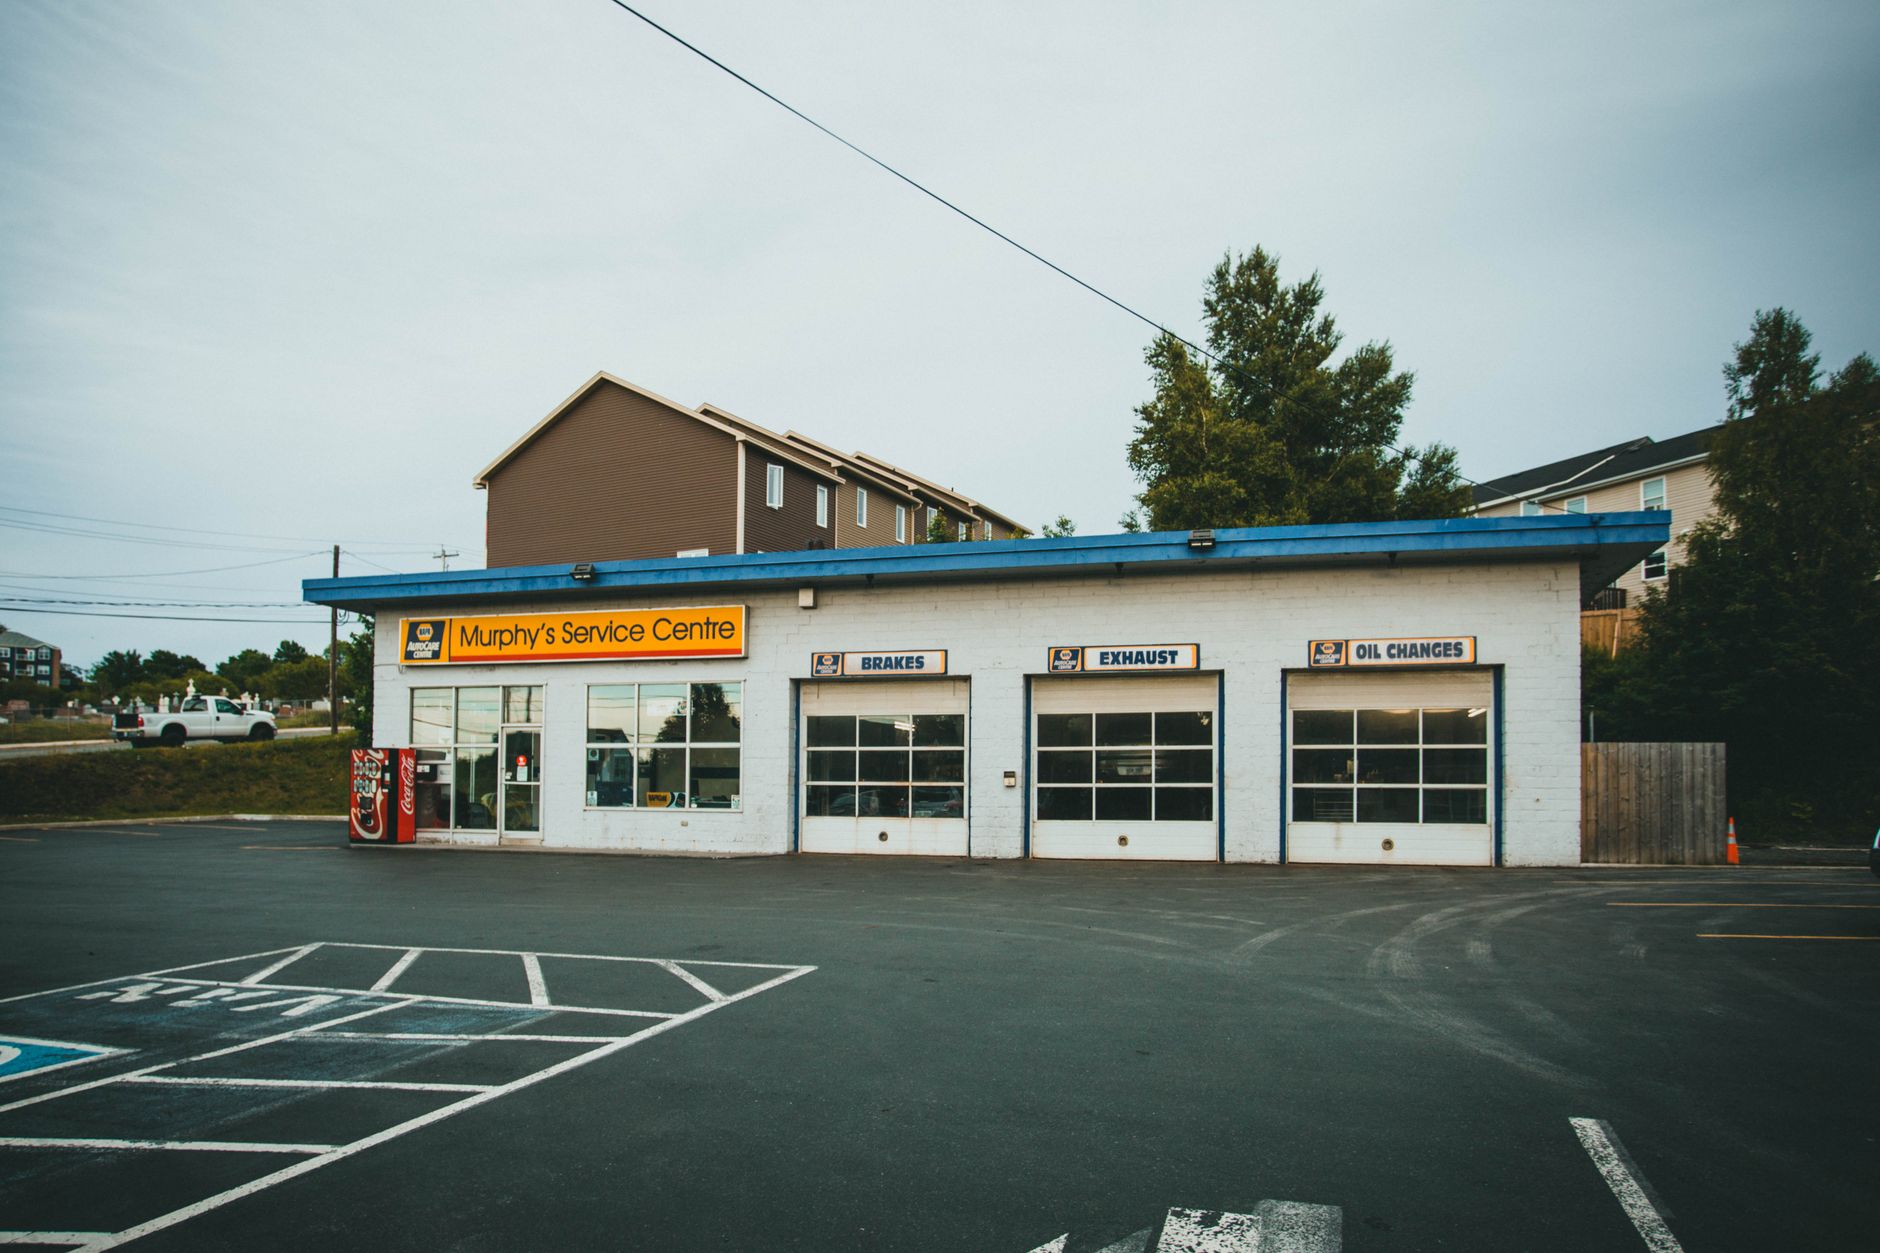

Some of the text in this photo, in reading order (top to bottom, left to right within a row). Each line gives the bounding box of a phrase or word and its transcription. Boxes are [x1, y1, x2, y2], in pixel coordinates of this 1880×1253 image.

[460, 616, 735, 651] Murphy's Service Centre
[1099, 650, 1178, 665] EXHAUST
[1356, 644, 1381, 659] OIL
[1386, 642, 1463, 659] CHANGES
[861, 656, 925, 670] BRAKES
[401, 753, 414, 815] Coca-Cola
